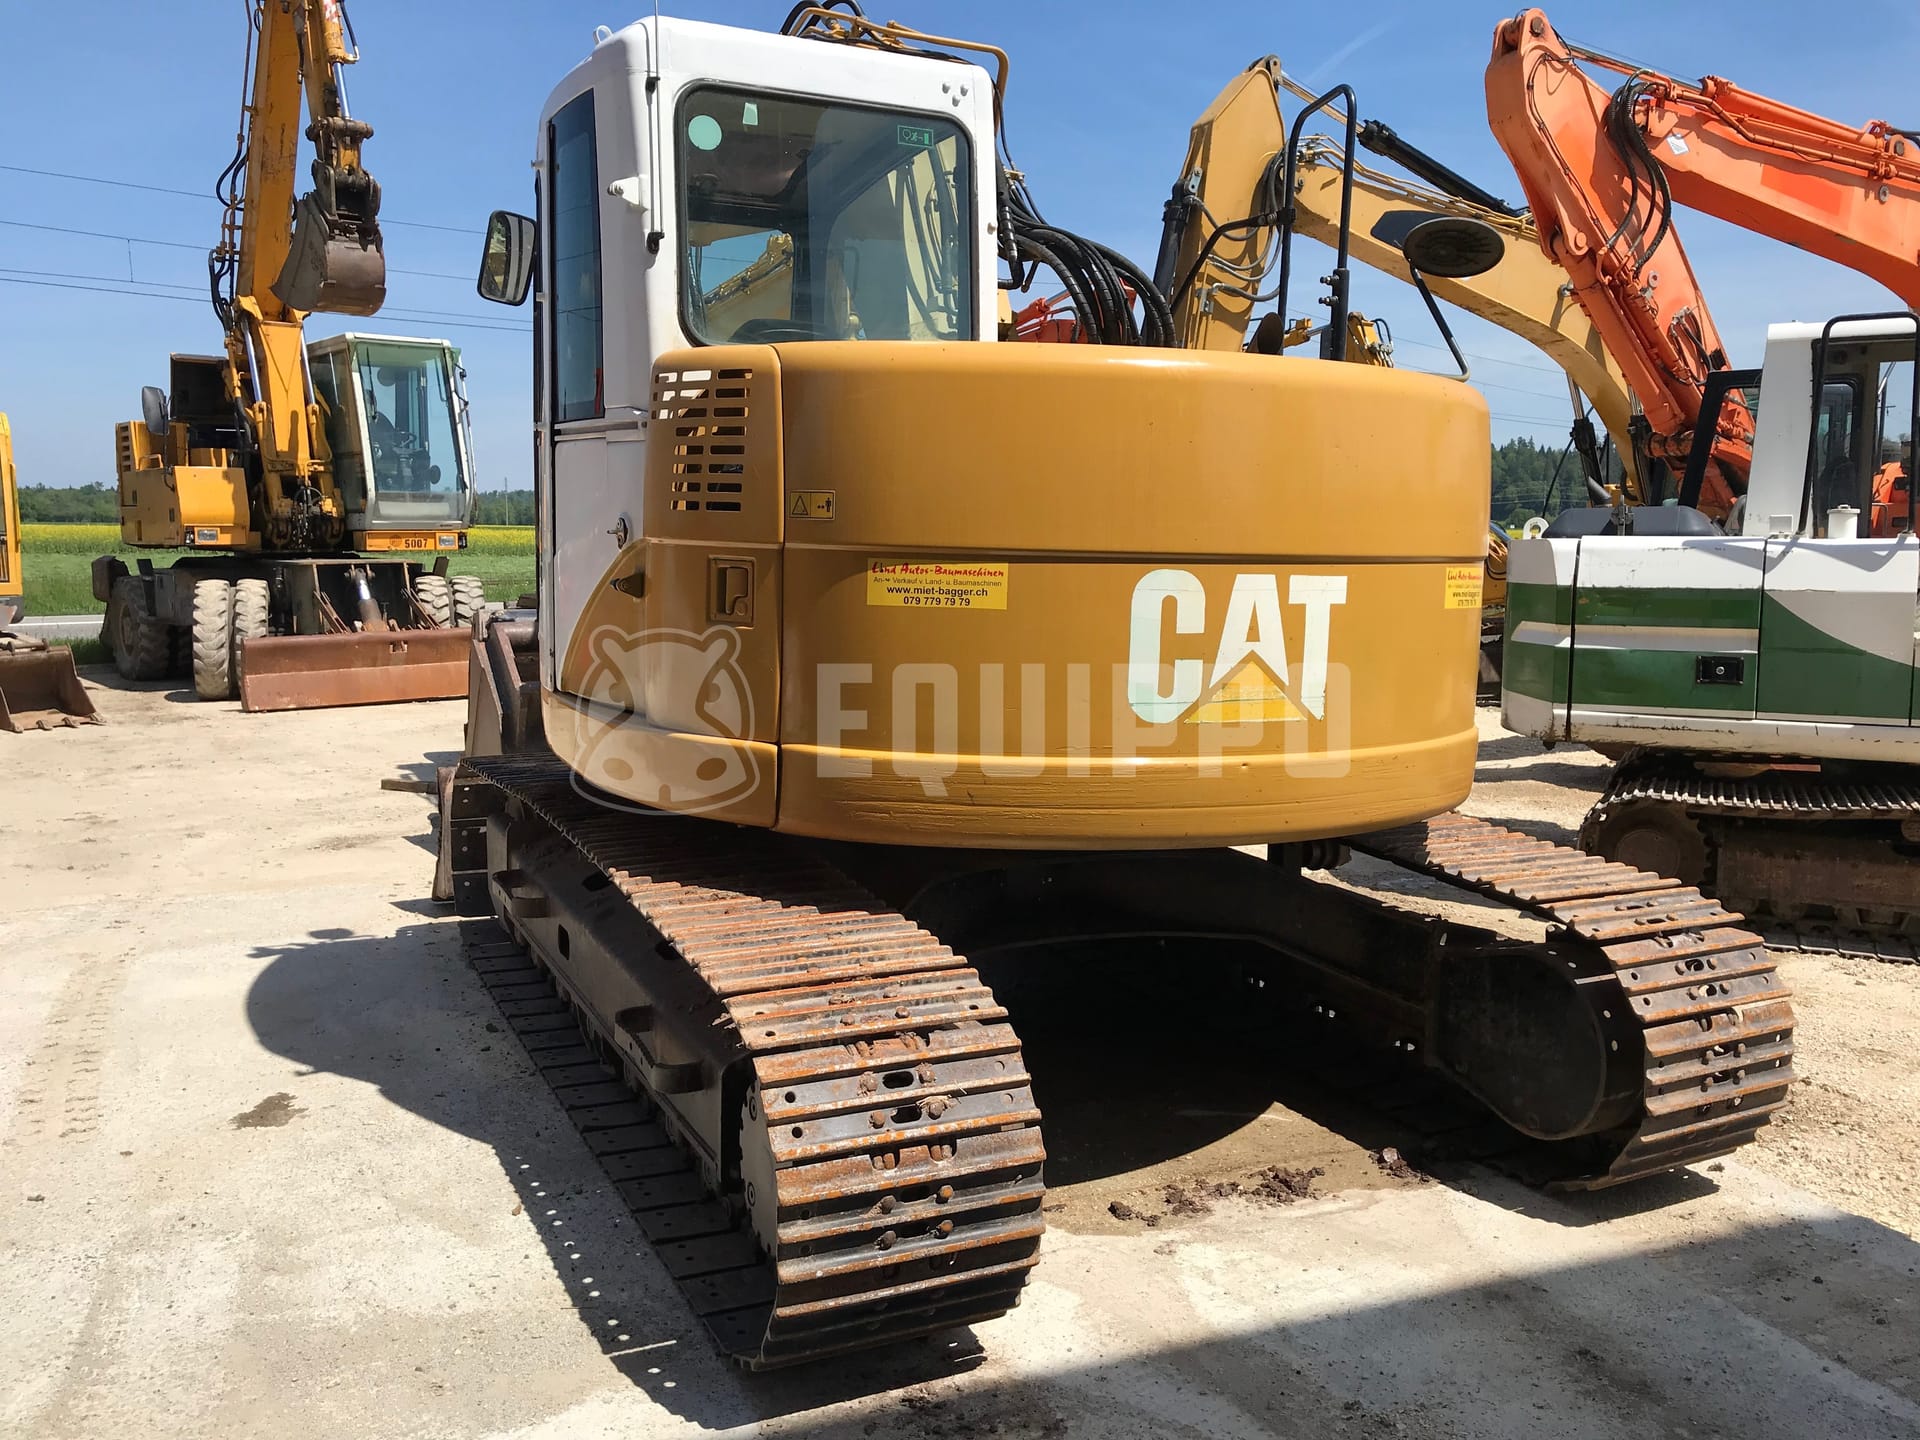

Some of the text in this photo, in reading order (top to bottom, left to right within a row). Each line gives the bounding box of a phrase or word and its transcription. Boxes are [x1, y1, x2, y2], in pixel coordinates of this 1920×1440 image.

[404, 538, 427, 549] 5007
[953, 579, 1002, 587] Baumaschinen
[886, 586, 988, 598] www.miet-bagger.ch
[903, 596, 971, 606] 079 779 79 79
[1127, 568, 1348, 724] CAT
